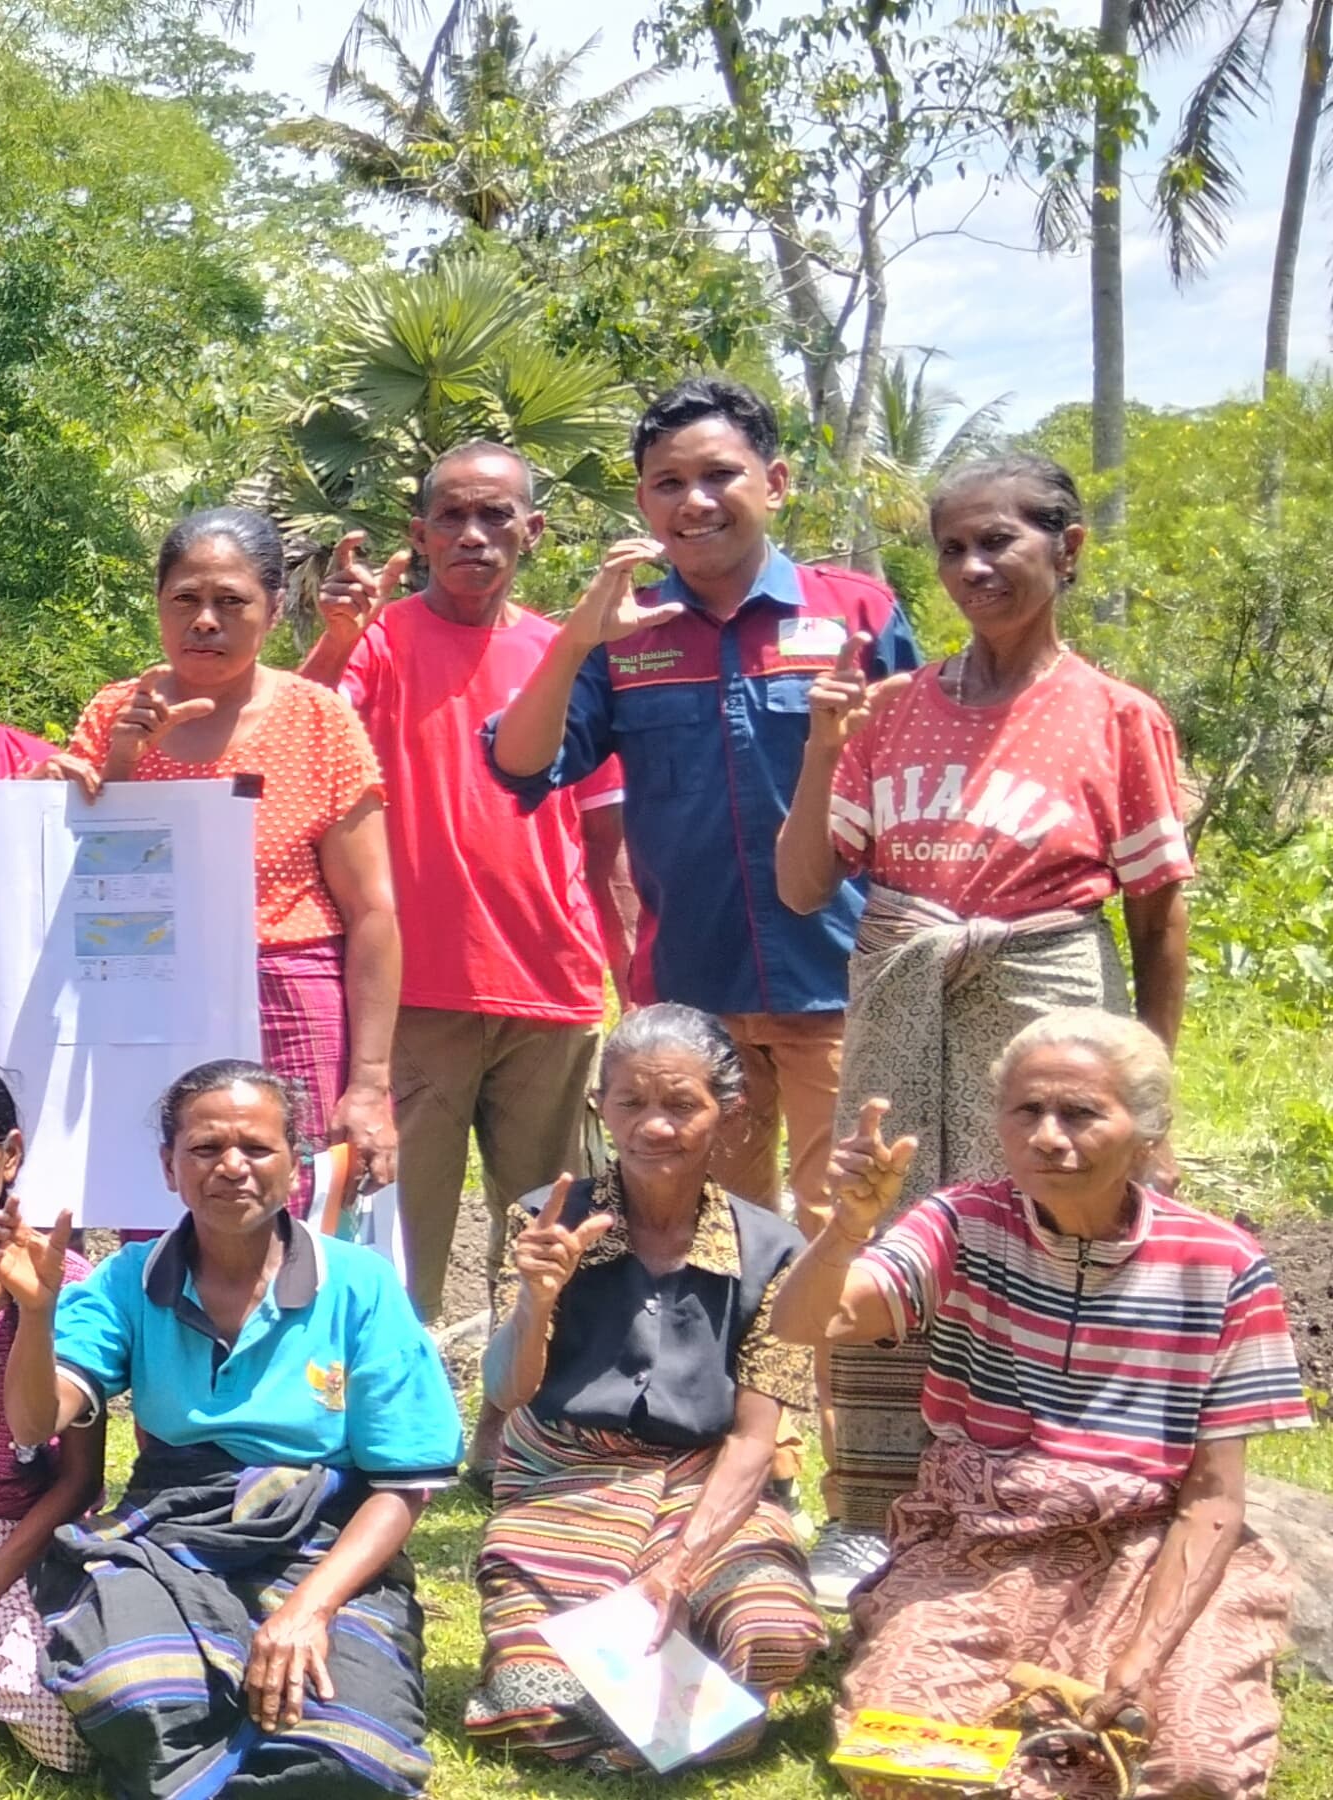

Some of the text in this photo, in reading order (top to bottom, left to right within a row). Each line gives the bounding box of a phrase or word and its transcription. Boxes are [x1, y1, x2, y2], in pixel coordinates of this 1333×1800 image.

[610, 649, 684, 664] Small Initiative
[619, 660, 675, 674] Big Impact
[891, 842, 990, 862] FLORIDA
